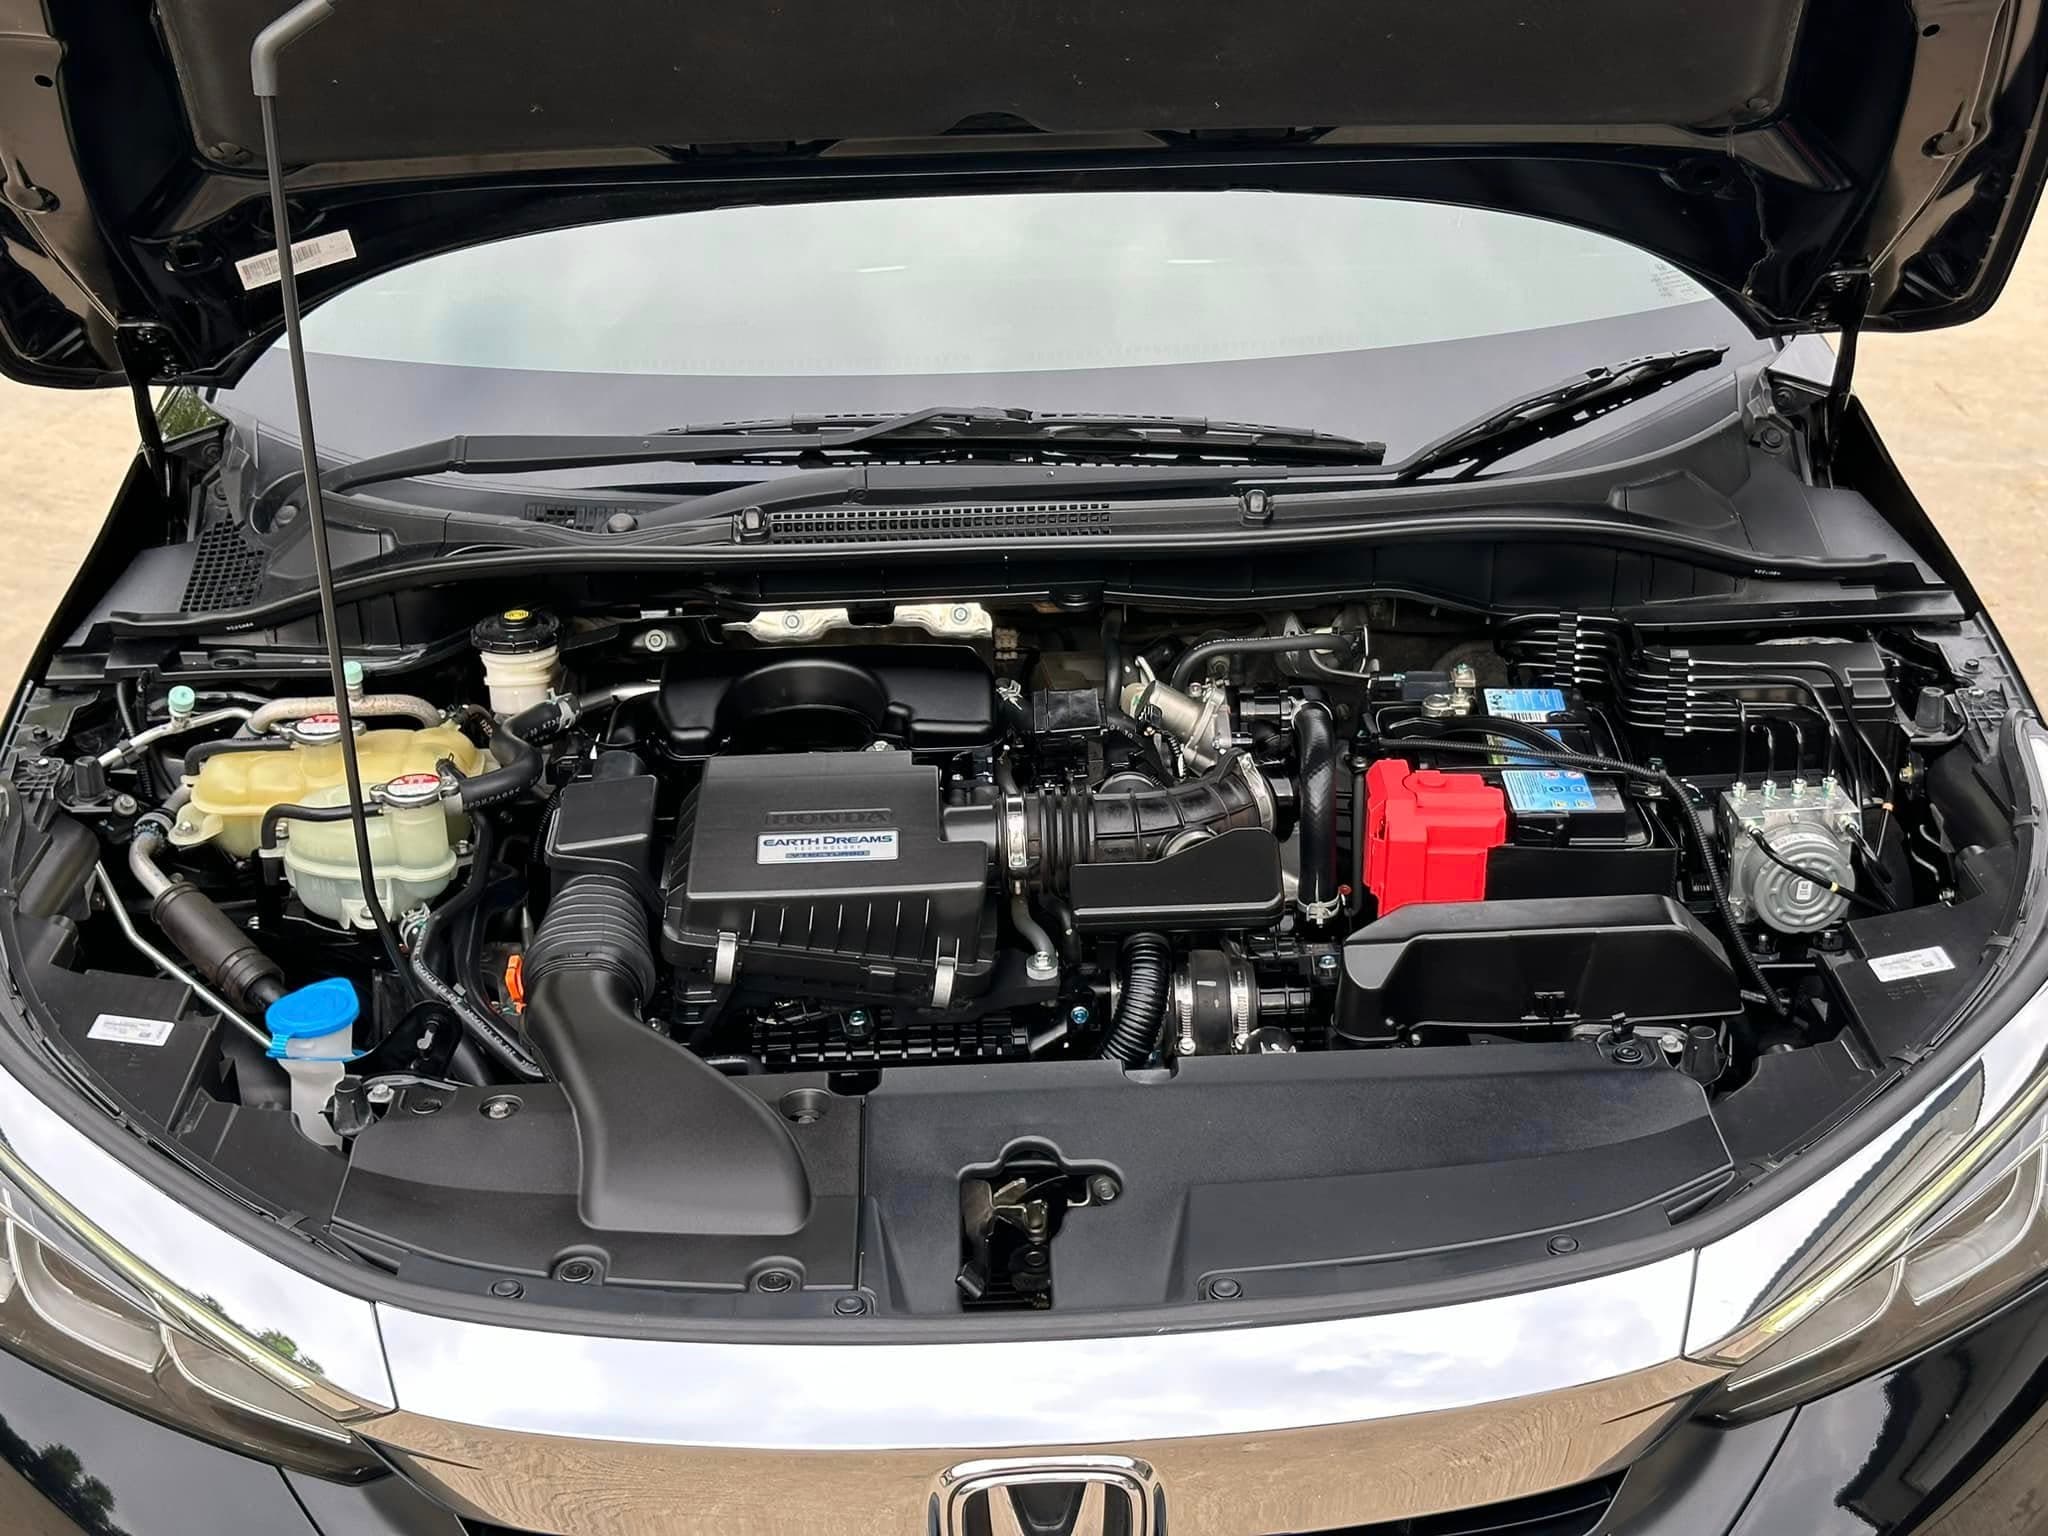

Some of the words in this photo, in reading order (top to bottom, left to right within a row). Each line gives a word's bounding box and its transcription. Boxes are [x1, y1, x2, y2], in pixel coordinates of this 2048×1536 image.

[771, 811, 889, 826] HONDA
[763, 838, 819, 847] EARTH
[823, 835, 893, 846] DREAMS
